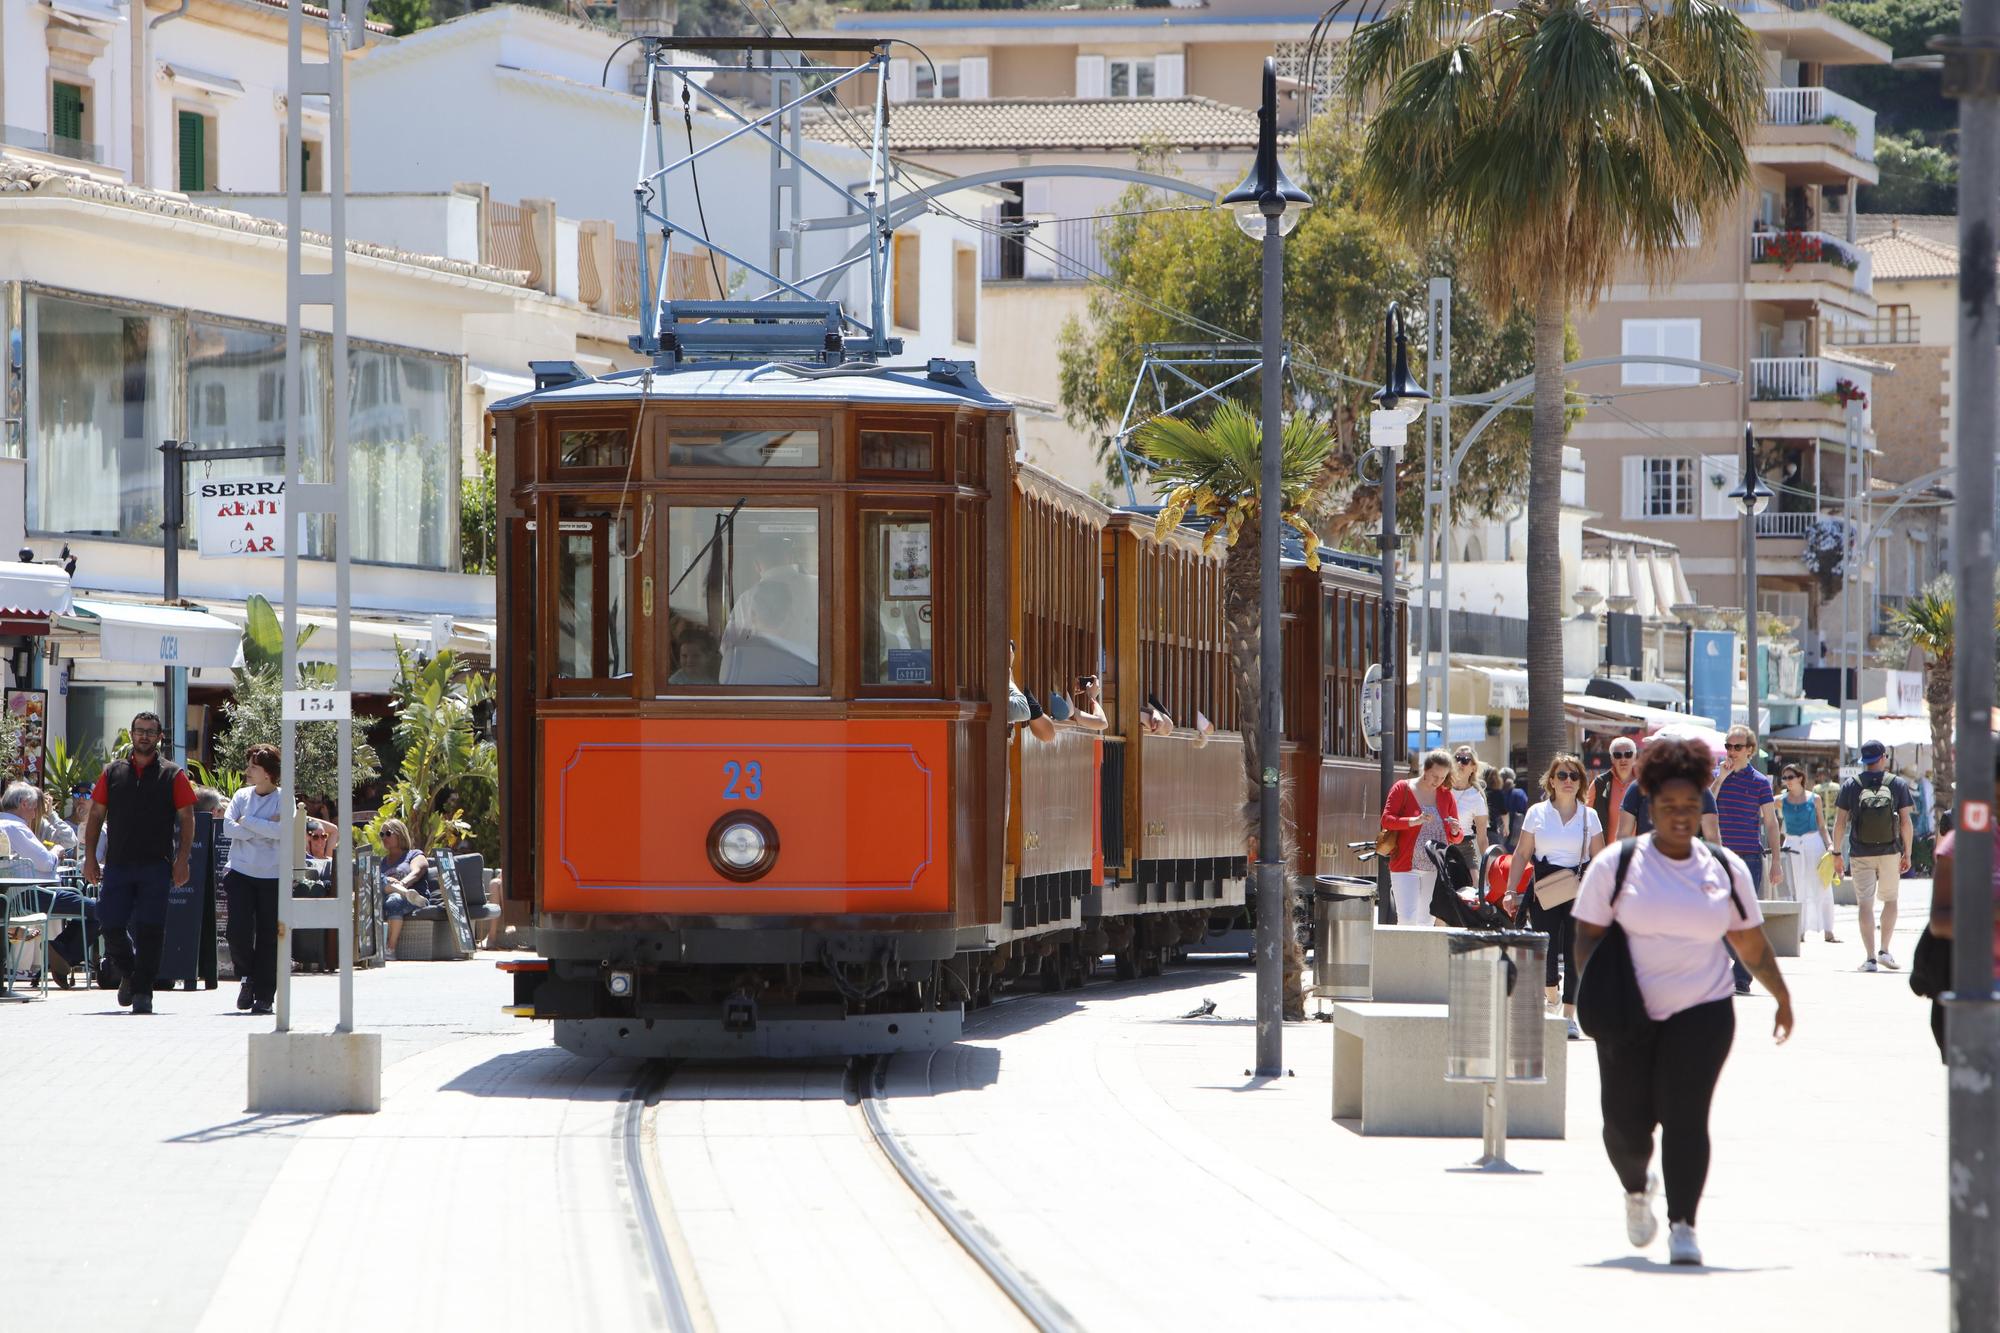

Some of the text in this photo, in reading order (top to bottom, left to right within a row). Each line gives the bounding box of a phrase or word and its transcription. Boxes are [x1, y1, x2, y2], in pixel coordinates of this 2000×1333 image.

[217, 499, 280, 517] RENT
[244, 521, 254, 531] A
[230, 536, 275, 554] CAR
[722, 760, 762, 800] 23
